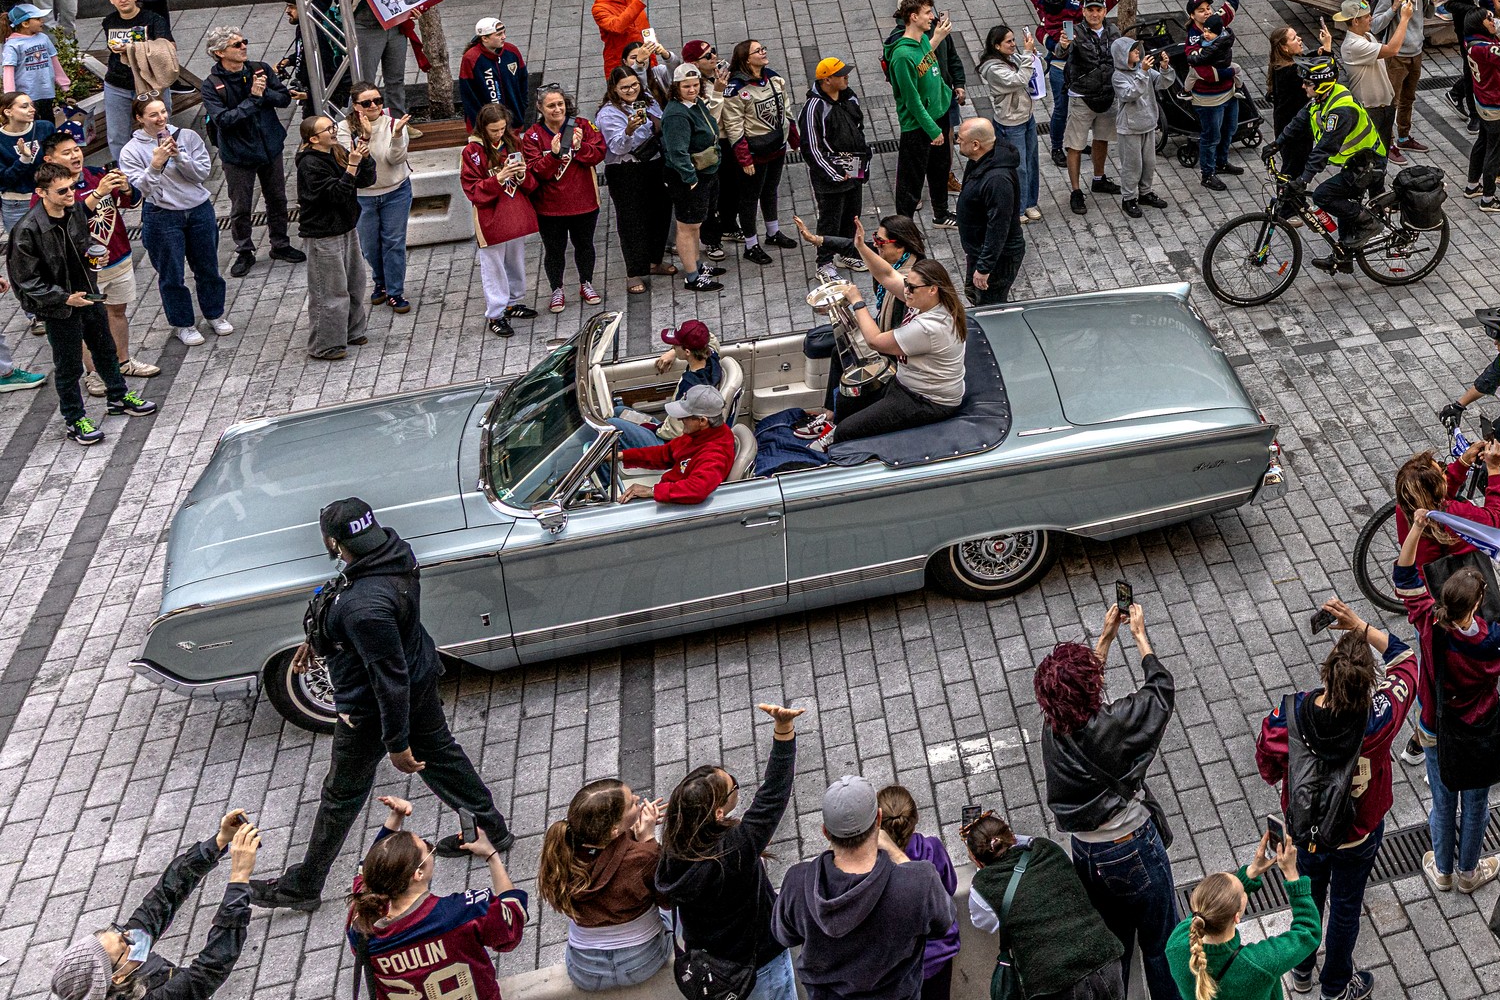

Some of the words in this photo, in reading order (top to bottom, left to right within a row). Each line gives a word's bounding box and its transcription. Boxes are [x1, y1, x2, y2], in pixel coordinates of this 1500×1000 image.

[1310, 71, 1334, 80] GIRO
[349, 511, 374, 534] DLF
[377, 939, 449, 975] POULIN
